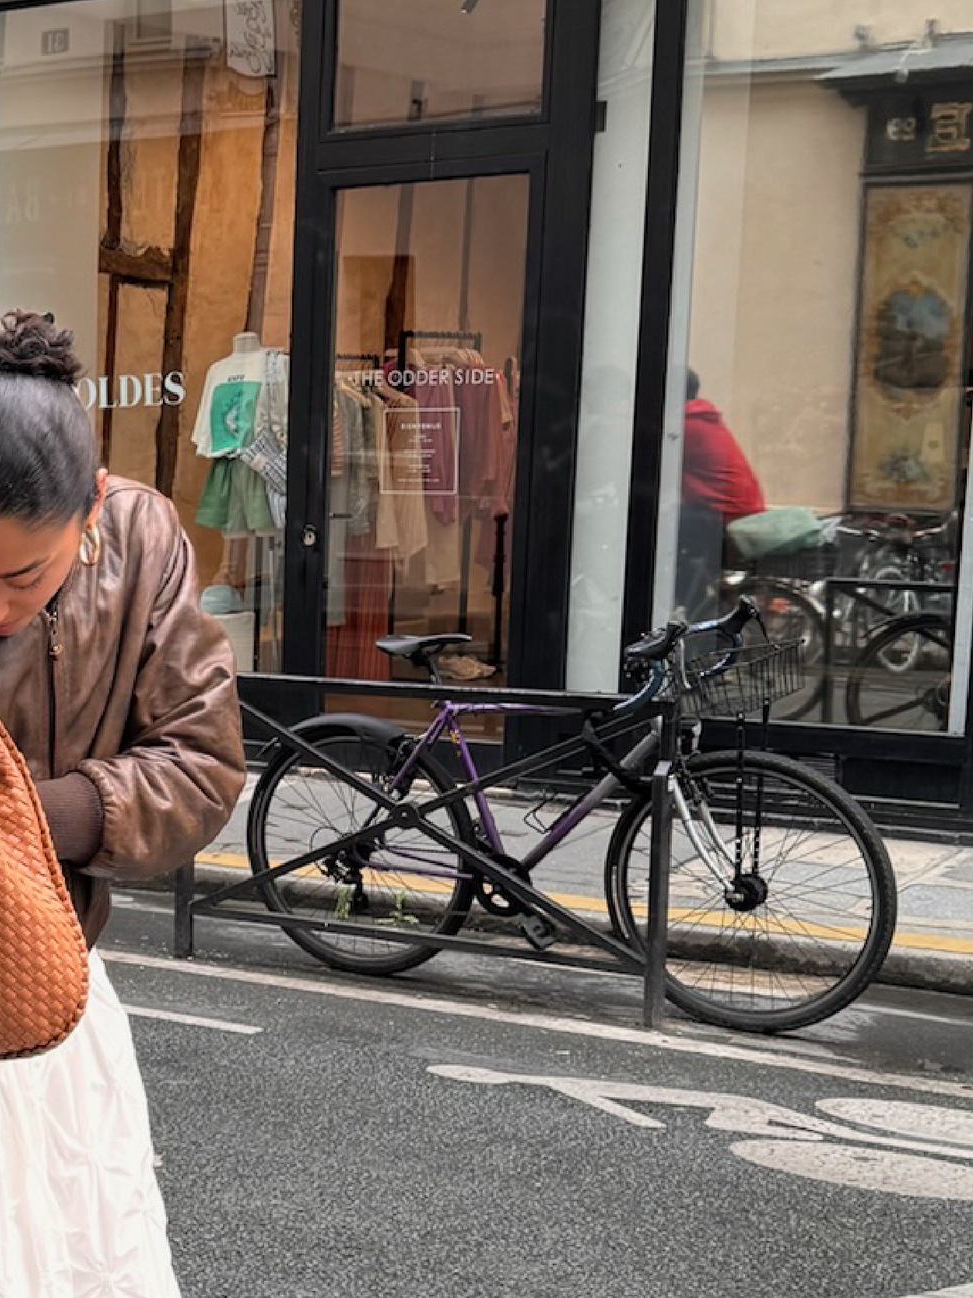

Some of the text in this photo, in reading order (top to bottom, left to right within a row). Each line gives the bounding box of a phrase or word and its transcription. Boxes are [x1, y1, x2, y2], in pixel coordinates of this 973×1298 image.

[73, 370, 186, 410] OLDES
[353, 368, 495, 387] THE ODDER SIDE
